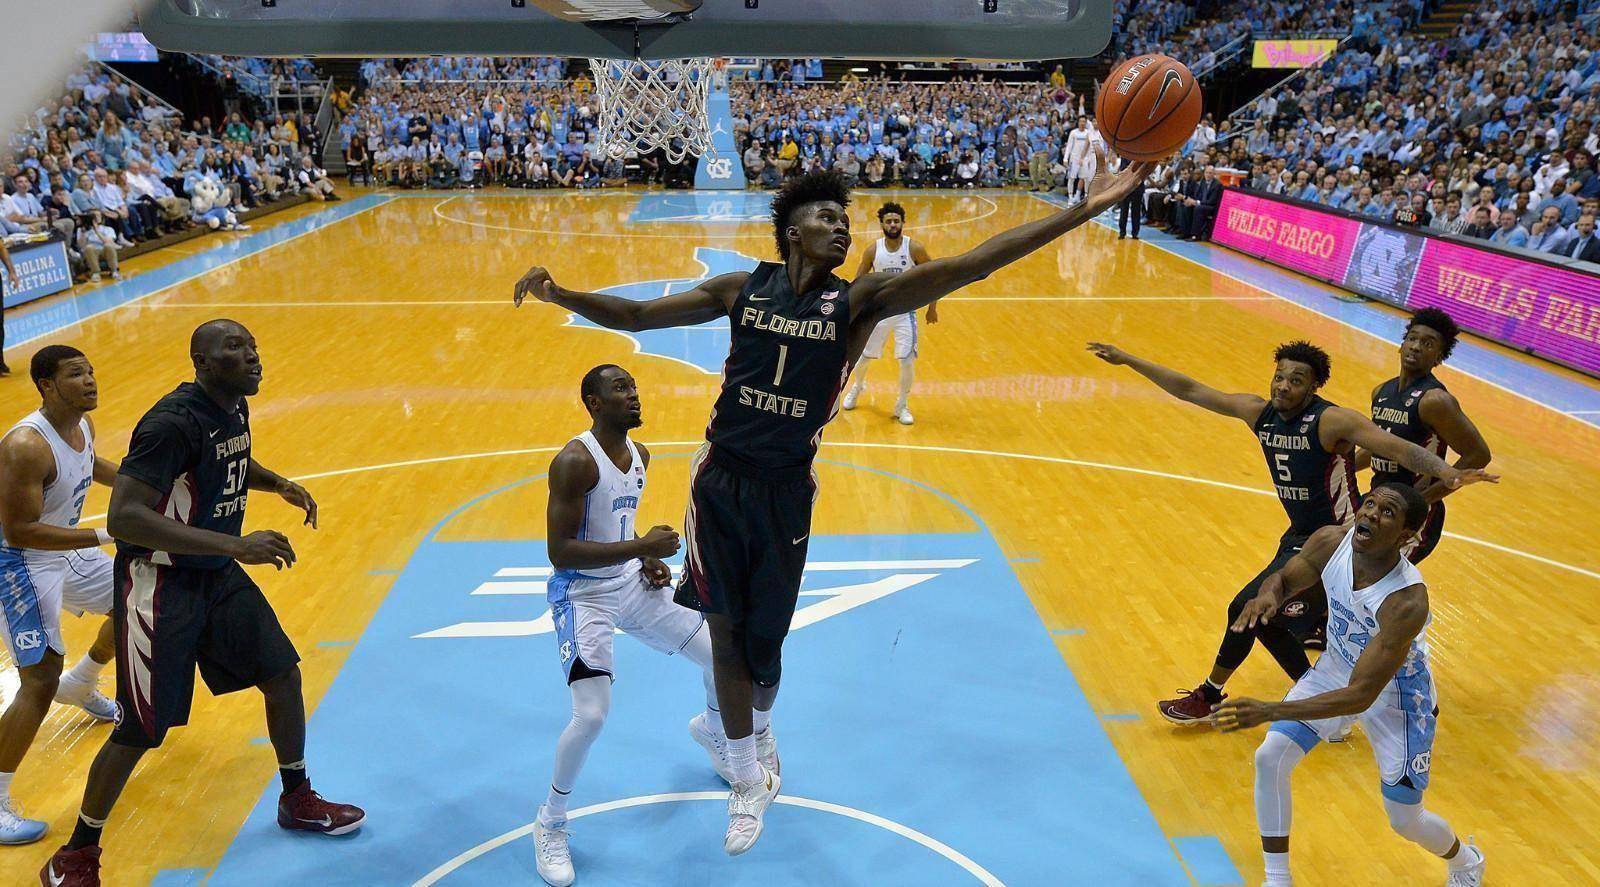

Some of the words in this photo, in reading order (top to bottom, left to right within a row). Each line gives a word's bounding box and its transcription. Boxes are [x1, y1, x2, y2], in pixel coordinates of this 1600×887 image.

[1227, 207, 1277, 242] WELLS
[1276, 221, 1336, 260] FARGO
[0, 255, 56, 281] CROLINA
[3, 267, 66, 297] ASKETBALL
[1437, 265, 1539, 321] WELLS
[740, 306, 837, 341] FLORIDA
[773, 345, 788, 387] 1
[738, 385, 808, 418] STATE
[1372, 406, 1409, 425] FLORIDA
[1258, 431, 1311, 450] FLORIDA
[222, 457, 248, 496] 50
[1274, 453, 1292, 482] 5
[611, 495, 639, 513] NORTH
[1274, 483, 1309, 500] TATE
[68, 494, 86, 527] 3
[212, 495, 247, 519] STATE
[620, 512, 627, 541] 1
